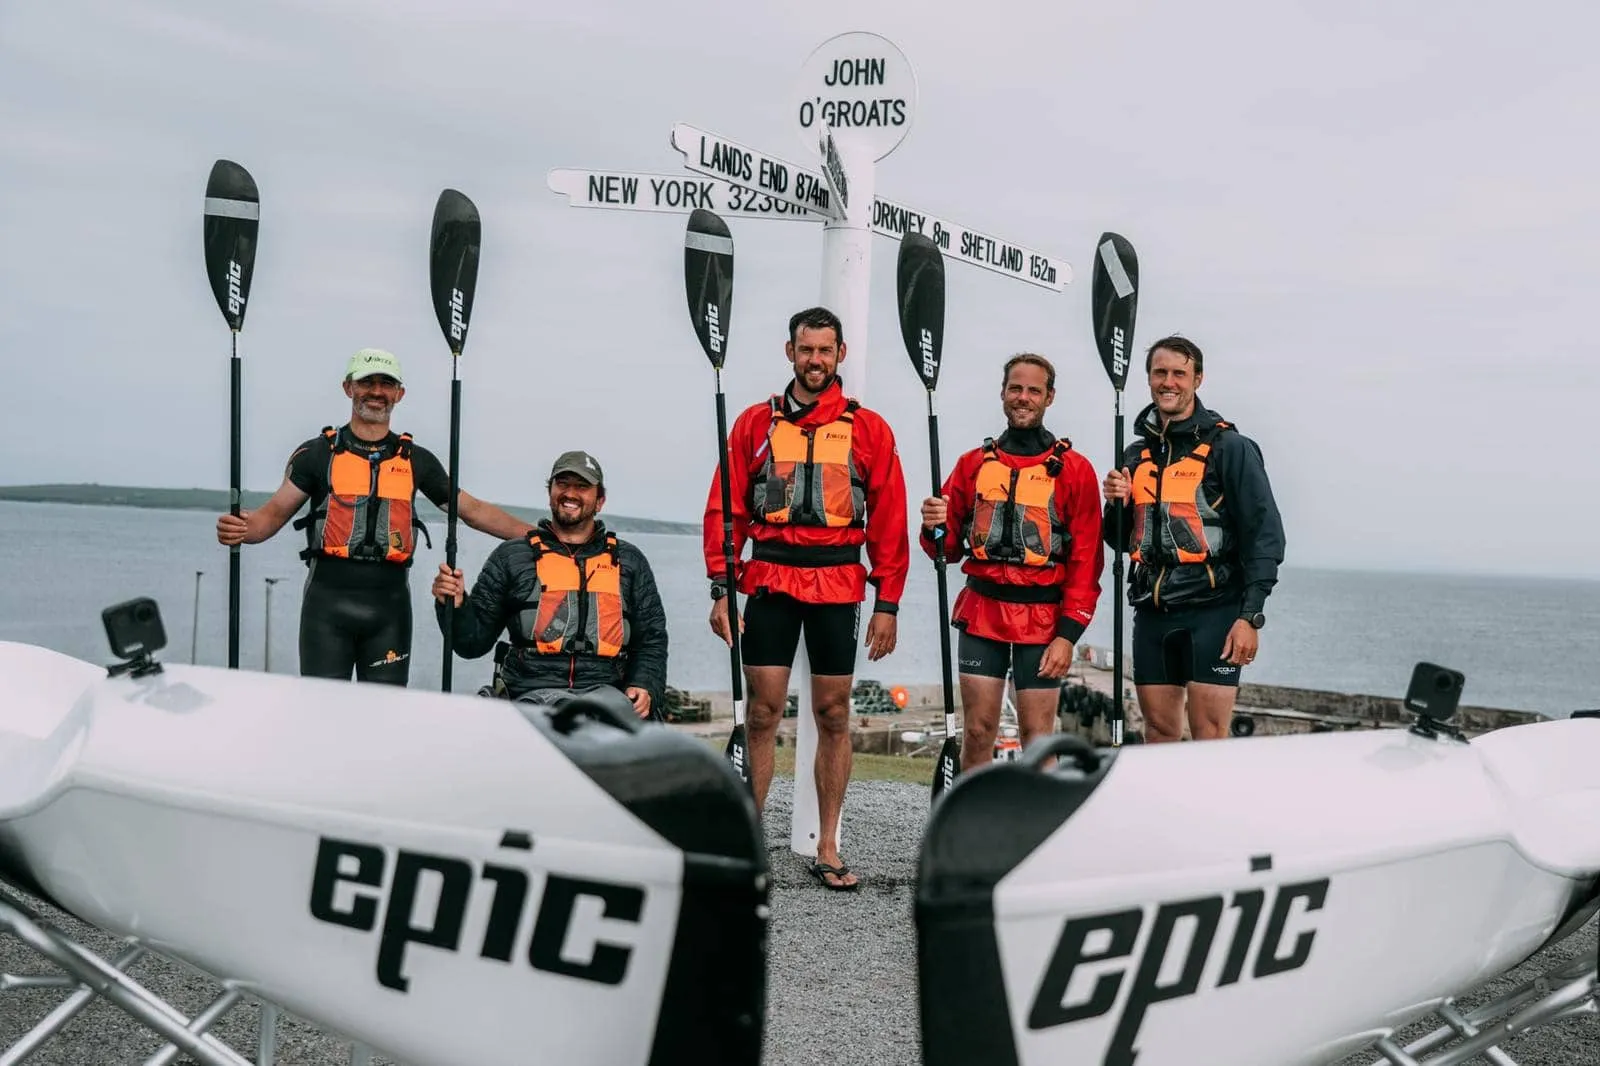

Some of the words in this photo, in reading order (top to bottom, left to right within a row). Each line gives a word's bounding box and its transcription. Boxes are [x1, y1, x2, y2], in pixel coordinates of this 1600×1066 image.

[824, 58, 886, 87] JOHN
[800, 97, 906, 128] O'GROATS
[588, 175, 639, 205] NEW
[650, 178, 714, 209] YORK
[701, 136, 753, 181] LANDS
[759, 158, 788, 194] END
[795, 173, 829, 209] 874m
[873, 200, 926, 234] ORKNEY
[932, 221, 950, 250] 8m
[960, 231, 1023, 273] SHETLAND
[1029, 254, 1057, 284] 152m
[225, 260, 246, 316] epic
[448, 287, 467, 341] epic
[705, 302, 725, 353] epic
[919, 327, 938, 378] epic
[1110, 326, 1129, 377] epic
[941, 755, 954, 795] pic
[310, 829, 647, 994] epic
[1027, 853, 1330, 1066] epic
